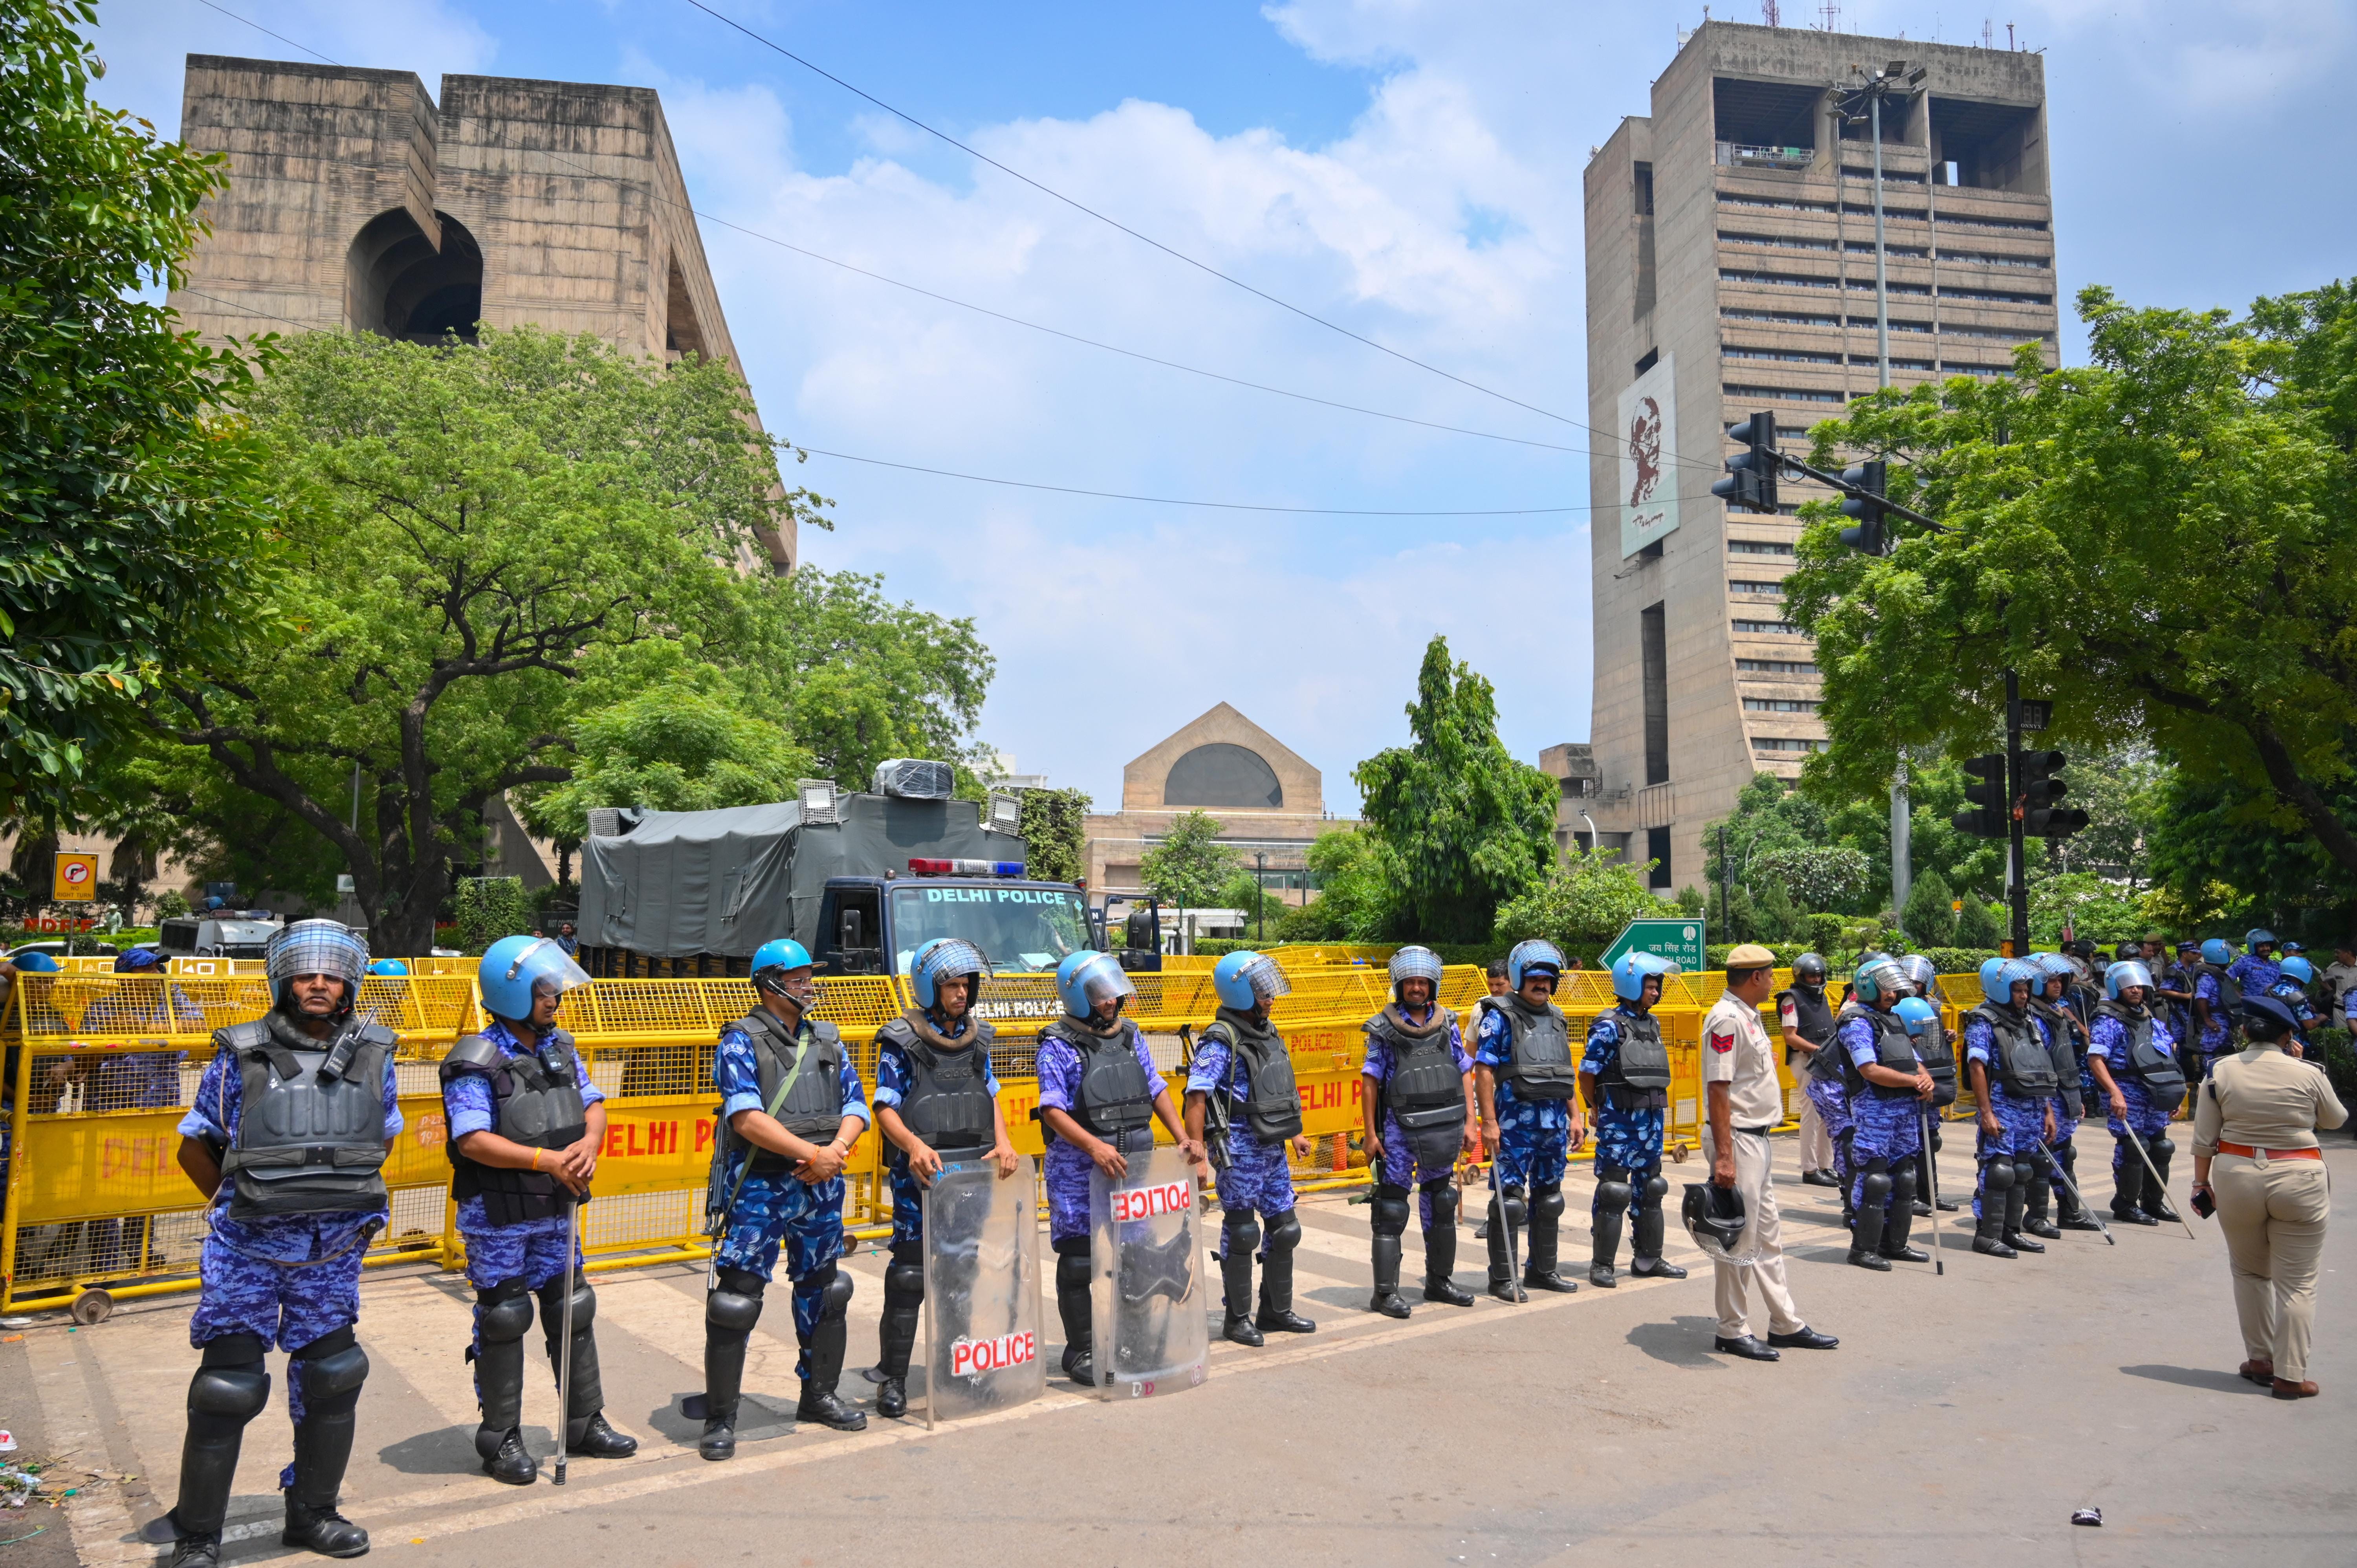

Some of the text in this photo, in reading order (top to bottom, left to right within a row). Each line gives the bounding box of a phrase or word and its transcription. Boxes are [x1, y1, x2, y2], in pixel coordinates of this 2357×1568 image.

[927, 888, 1066, 905] DELHI POLICE
[1664, 942, 1679, 953] सिंह
[1682, 942, 1696, 953] रोड
[1676, 956, 1697, 964] ROAD
[1014, 1000, 1065, 1017] POLICE
[1291, 1033, 1332, 1053] POLICE
[936, 1068, 973, 1079] POLICE
[1297, 1081, 1341, 1111] ELHI
[420, 1130, 441, 1145] 192
[1113, 1181, 1190, 1220] POLICE
[955, 1332, 1035, 1374] POLICE
